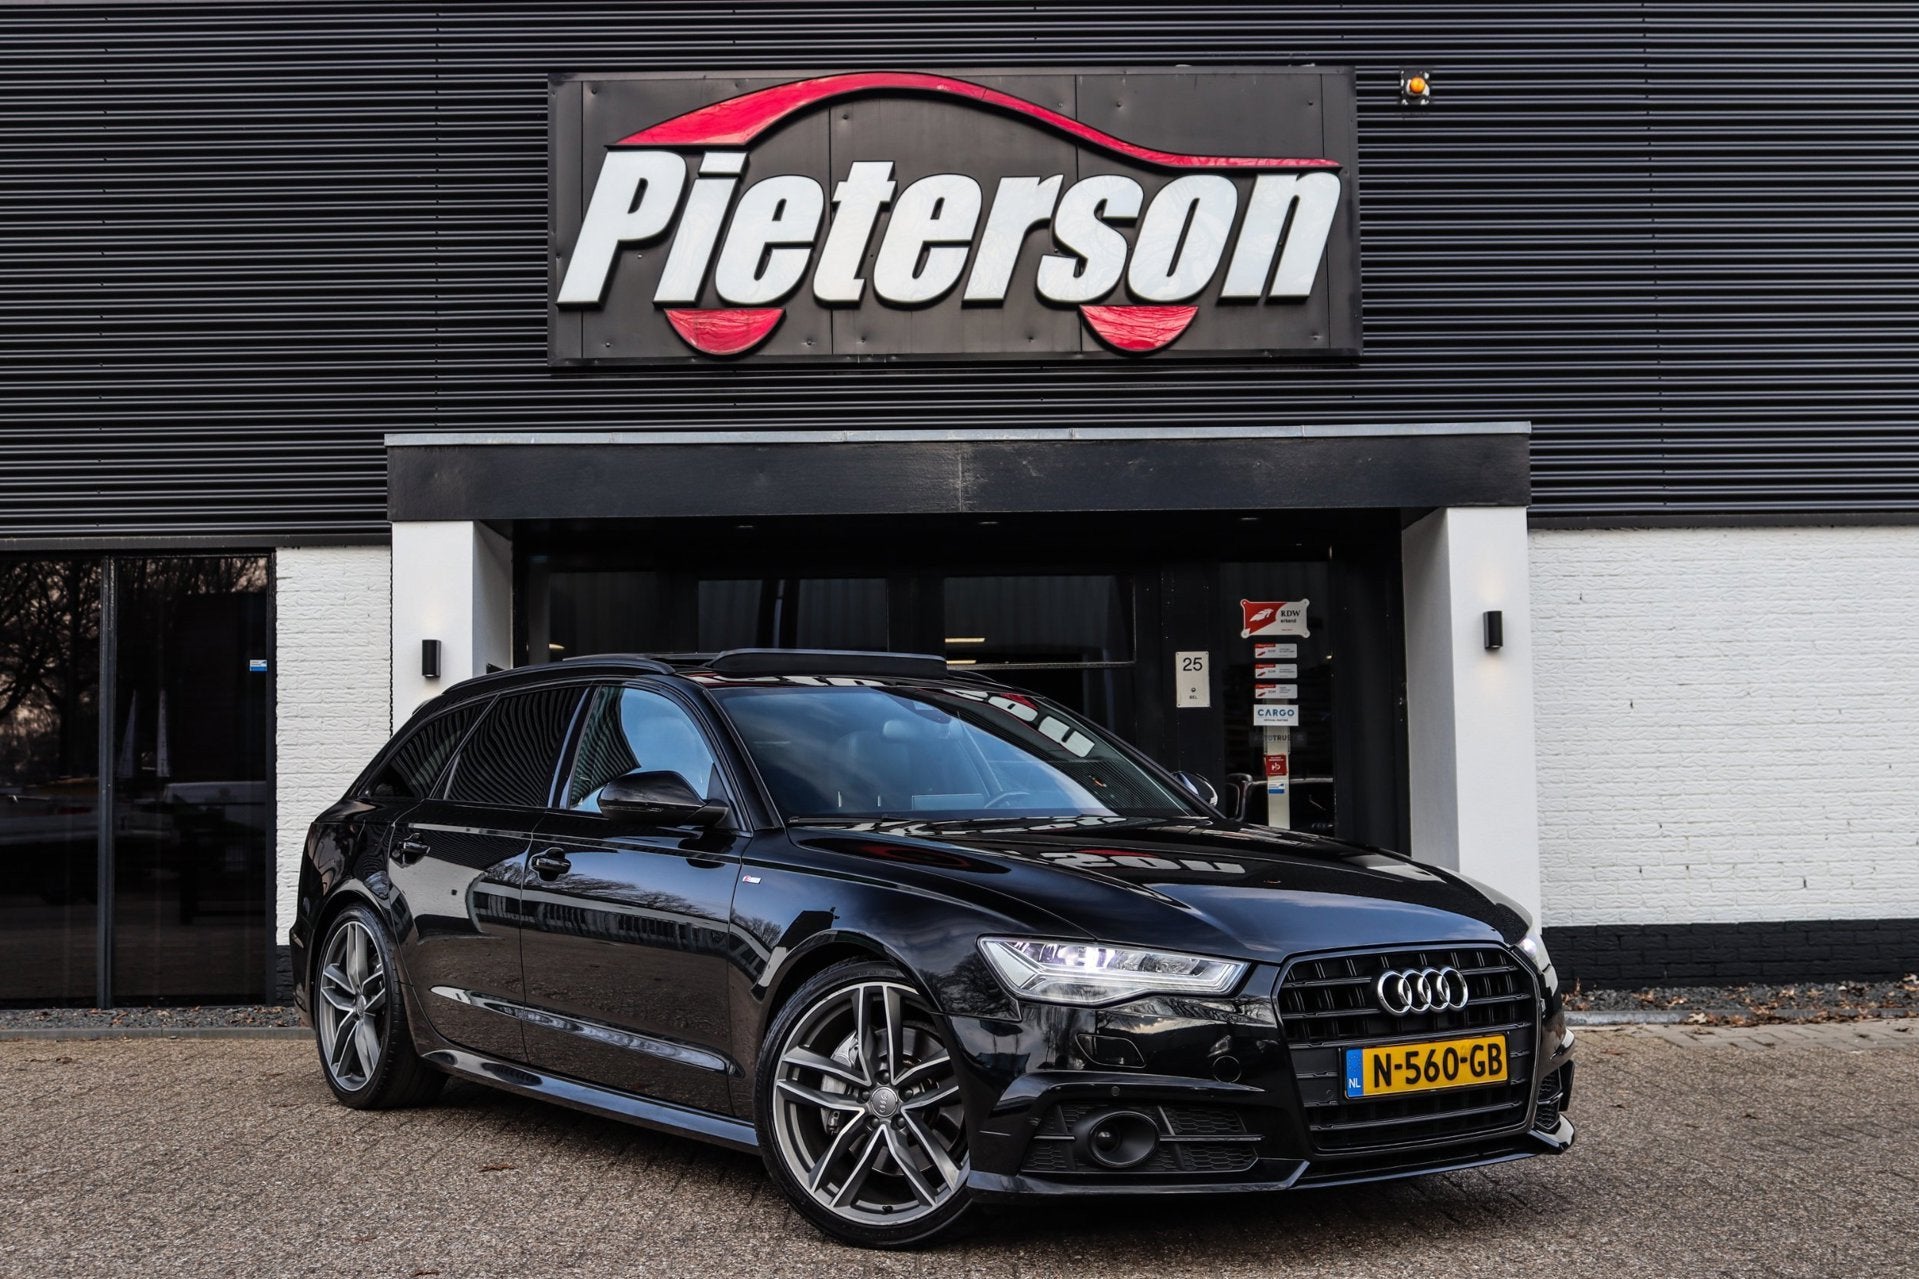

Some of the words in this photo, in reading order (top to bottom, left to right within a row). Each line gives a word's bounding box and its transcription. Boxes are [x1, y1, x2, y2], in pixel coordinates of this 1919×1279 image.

[556, 149, 1342, 306] Pieterson
[1280, 609, 1301, 617] RDW
[1182, 657, 1203, 671] 25
[1257, 708, 1295, 717] CARGO
[1373, 1043, 1503, 1088] N-560-GB
[1349, 1077, 1361, 1089] NL
